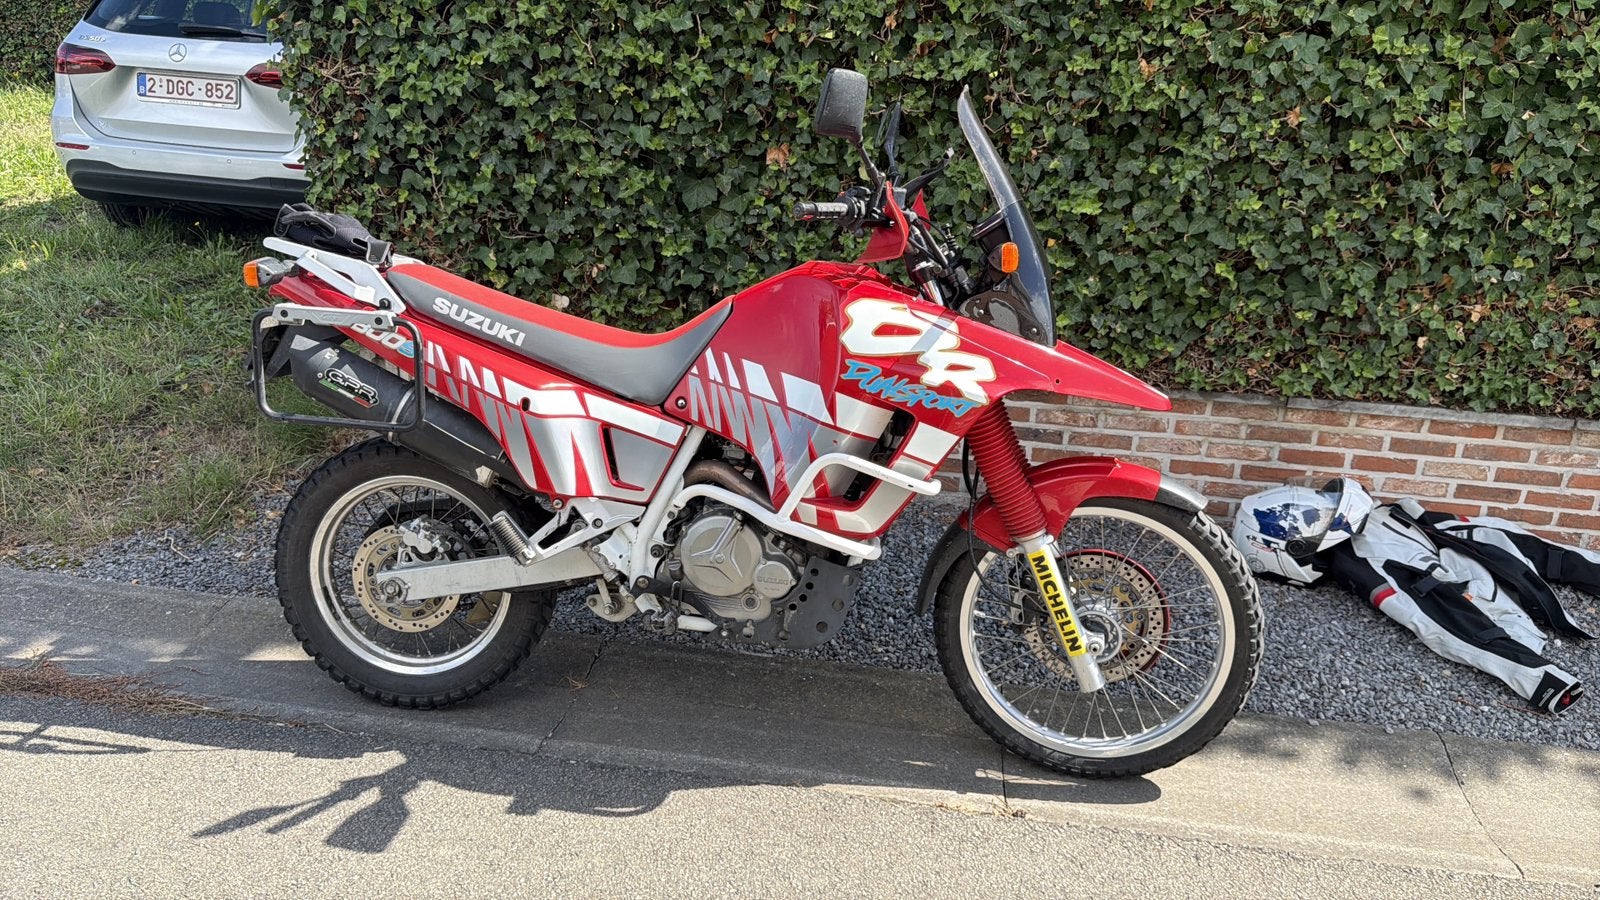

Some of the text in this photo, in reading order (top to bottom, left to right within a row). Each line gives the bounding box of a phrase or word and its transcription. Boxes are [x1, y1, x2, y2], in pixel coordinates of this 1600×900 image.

[139, 86, 145, 94] B
[431, 297, 526, 347] SUZUKI
[840, 297, 997, 406] DR
[840, 359, 981, 418] DUALSPORT
[1031, 554, 1082, 653] MICHELIN
